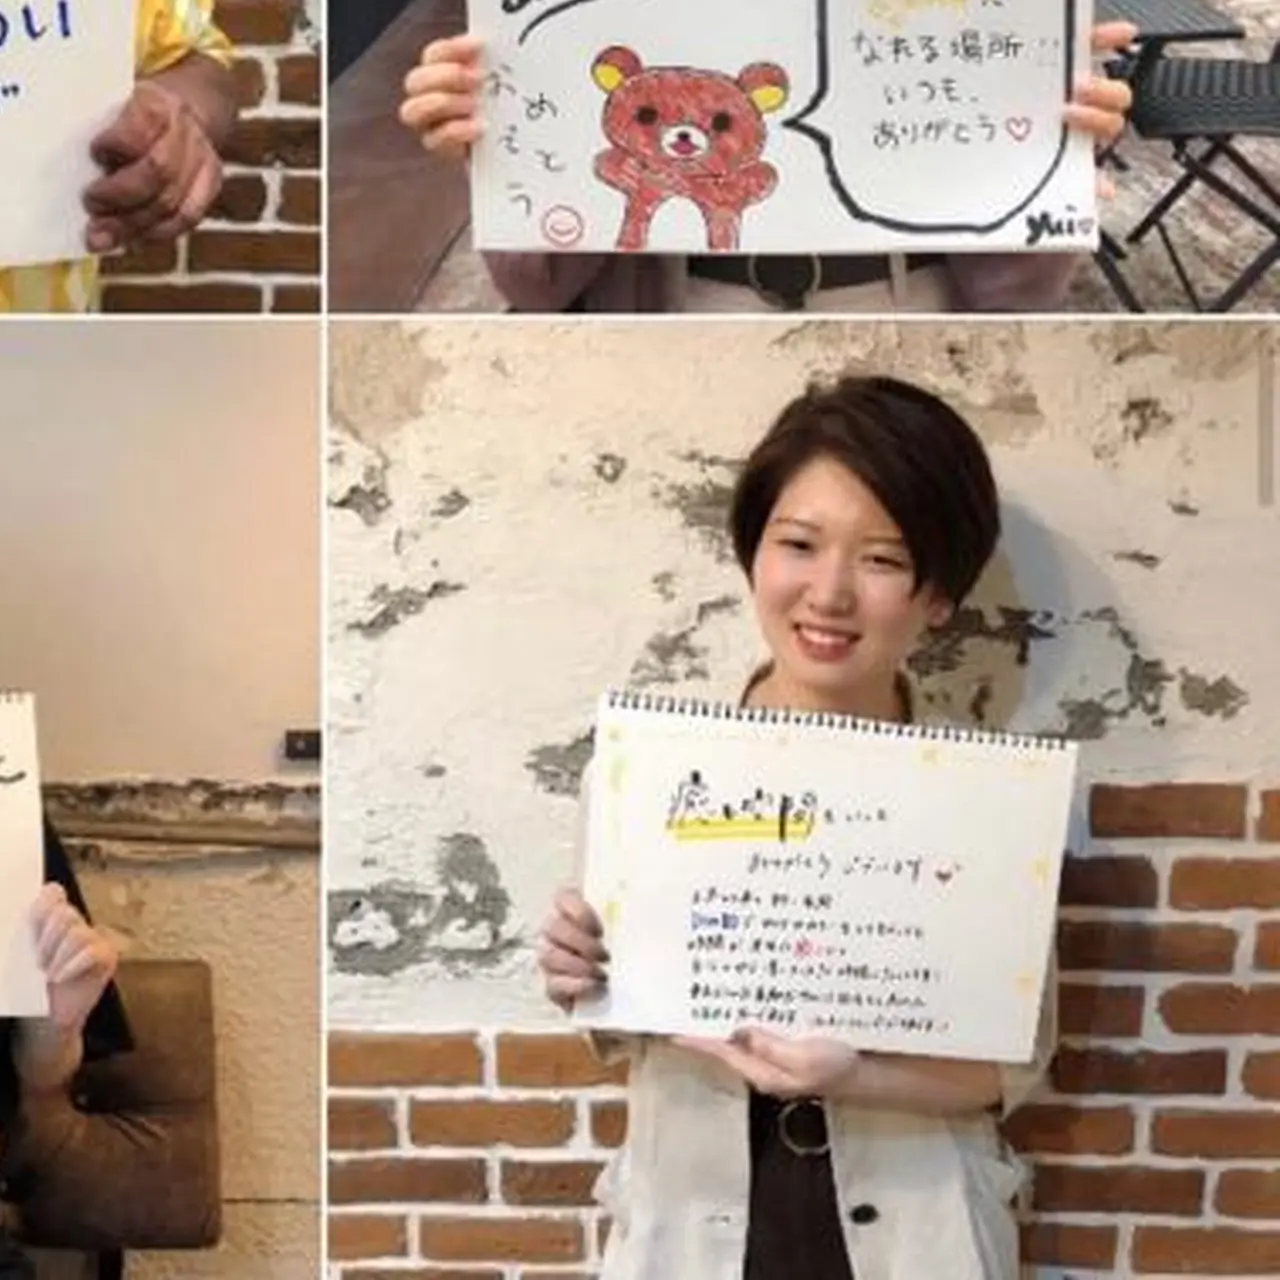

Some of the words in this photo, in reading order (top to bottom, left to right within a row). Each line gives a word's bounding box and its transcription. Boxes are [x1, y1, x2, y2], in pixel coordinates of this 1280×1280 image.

[873, 114, 999, 150] ありがとう
